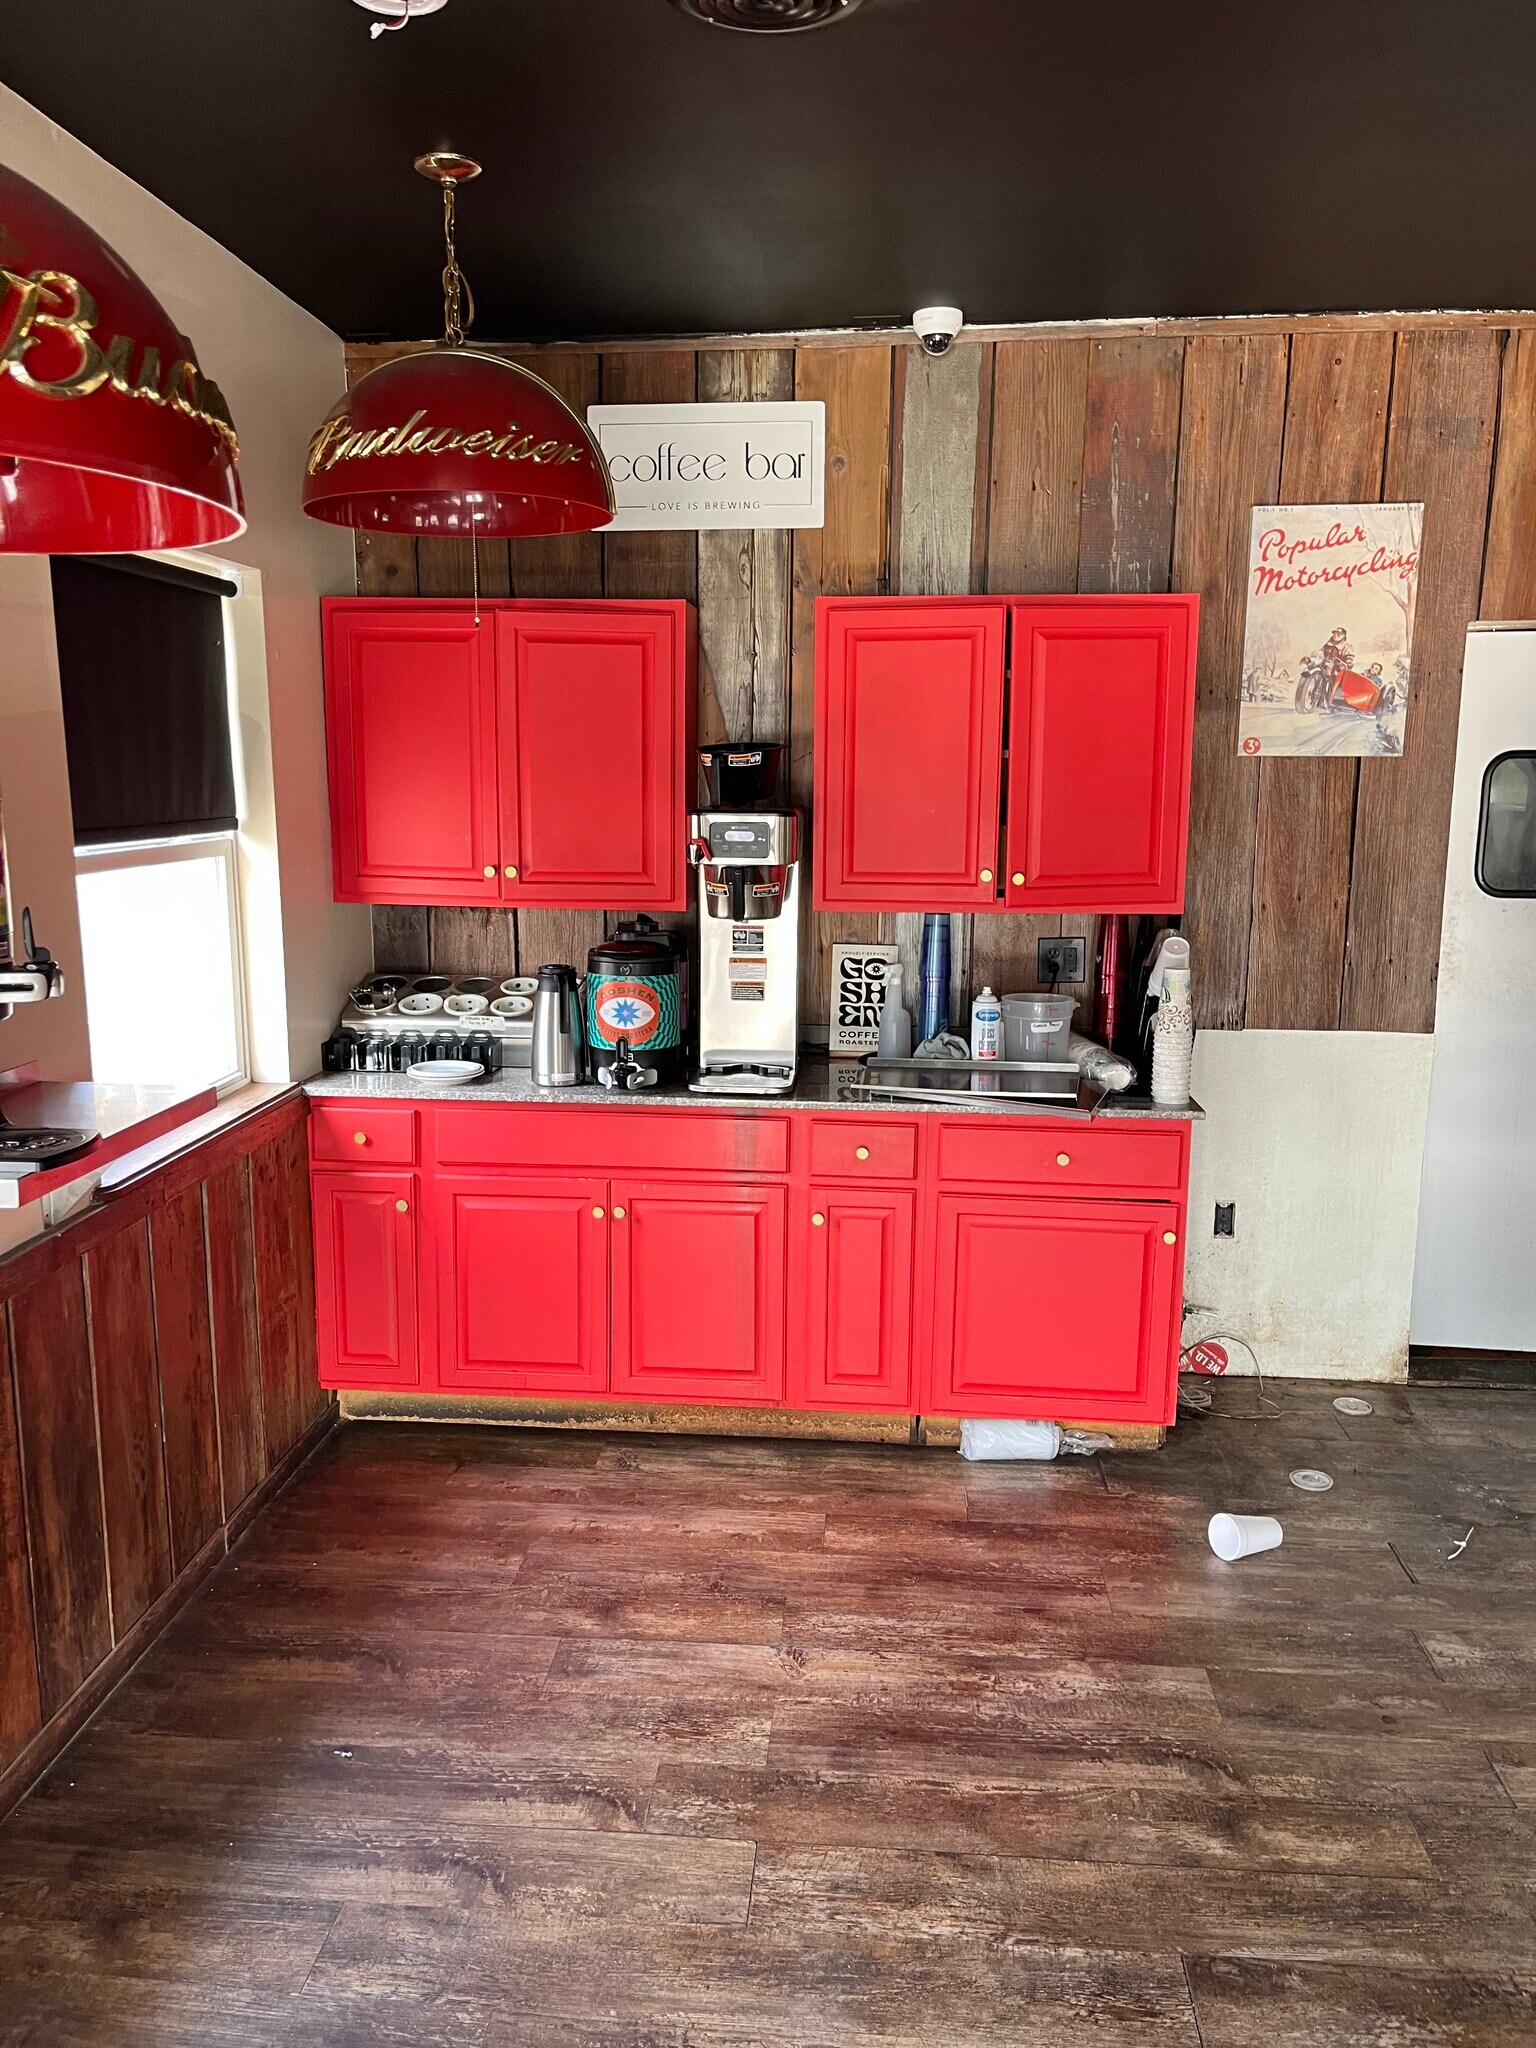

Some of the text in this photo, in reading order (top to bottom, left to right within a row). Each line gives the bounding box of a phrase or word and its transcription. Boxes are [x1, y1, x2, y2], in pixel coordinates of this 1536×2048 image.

[307, 409, 584, 475] Budweiser
[608, 442, 805, 482] coffee bar
[652, 501, 760, 511] LOVE IS BREWING
[1258, 523, 1367, 565] Popular
[1253, 546, 1418, 596] Motorcycling
[839, 1031, 879, 1039] COFFE
[982, 1028, 995, 1041] gass
